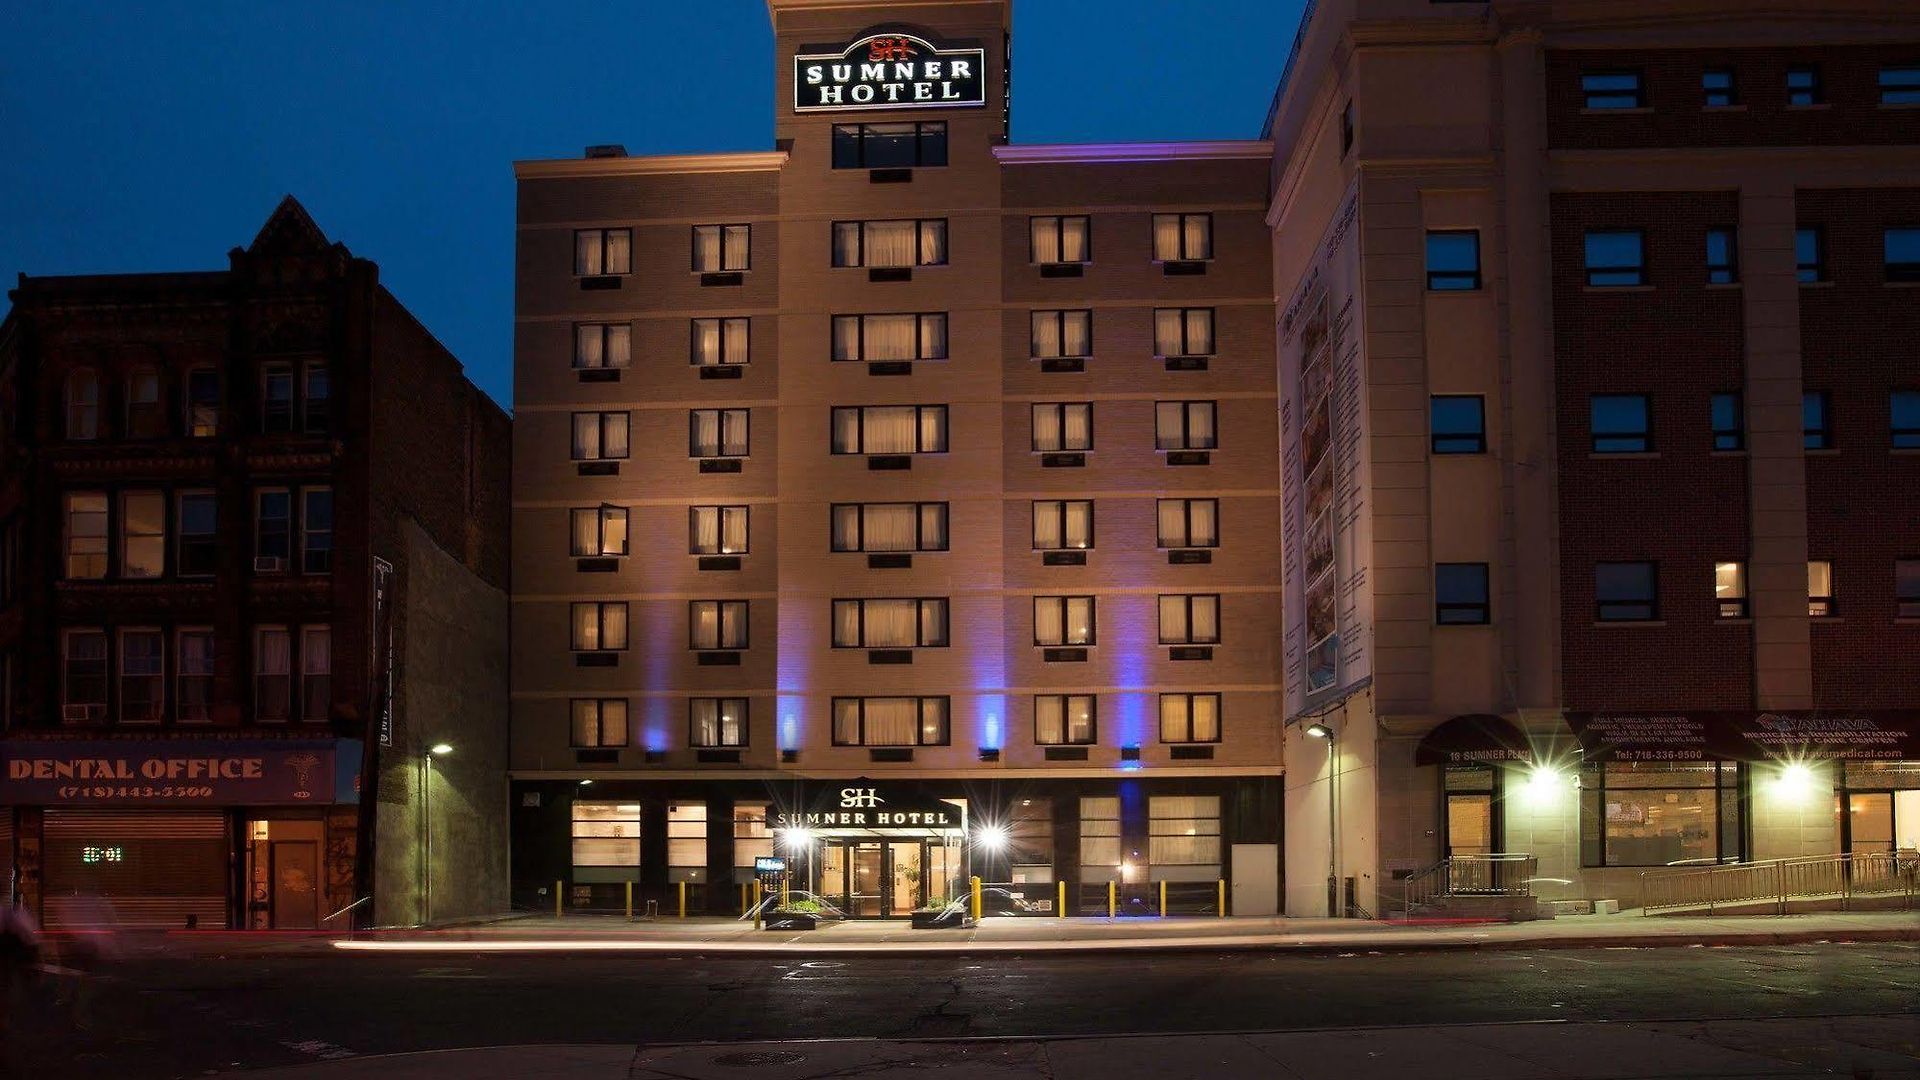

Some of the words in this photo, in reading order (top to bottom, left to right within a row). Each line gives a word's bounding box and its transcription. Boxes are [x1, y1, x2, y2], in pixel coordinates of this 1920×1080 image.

[806, 60, 972, 84] SUMNER
[819, 81, 960, 104] HOTEL
[1742, 731, 1796, 739] MEDICAL
[1463, 749, 1505, 761] SUMNER
[1635, 750, 1702, 759] 718-336-9500
[9, 760, 134, 779] DENTAL
[141, 759, 263, 778] OFFICE
[840, 788, 885, 808] SH
[777, 813, 866, 825] SUMNER
[878, 812, 949, 824] HOTEL
